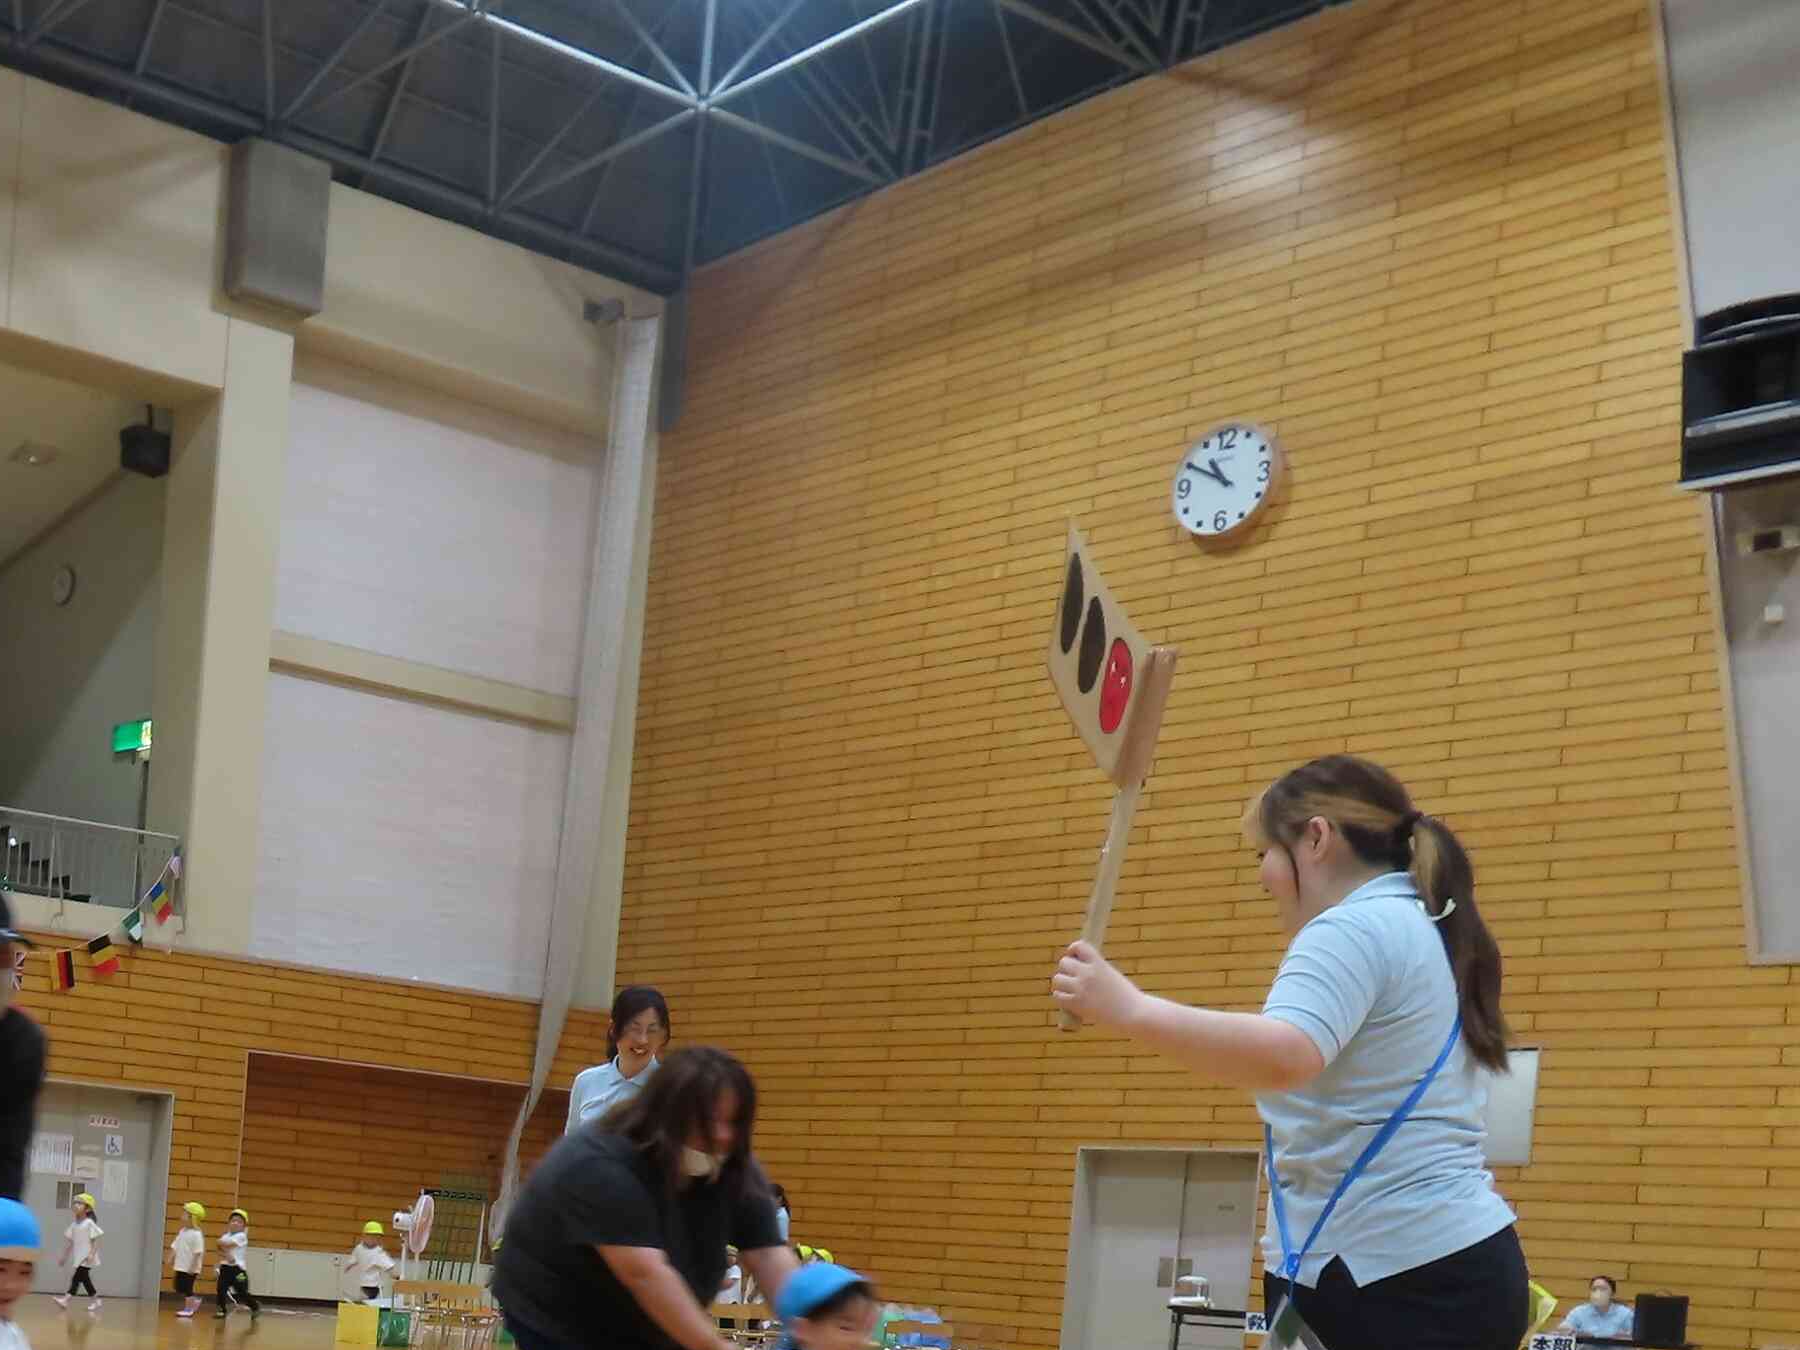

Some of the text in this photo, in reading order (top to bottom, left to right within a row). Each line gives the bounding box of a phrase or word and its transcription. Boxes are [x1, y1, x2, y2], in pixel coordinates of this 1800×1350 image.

[1218, 428, 1237, 450] 12
[1257, 460, 1270, 482] 3
[1177, 478, 1191, 499] 9
[1214, 510, 1227, 531] 6
